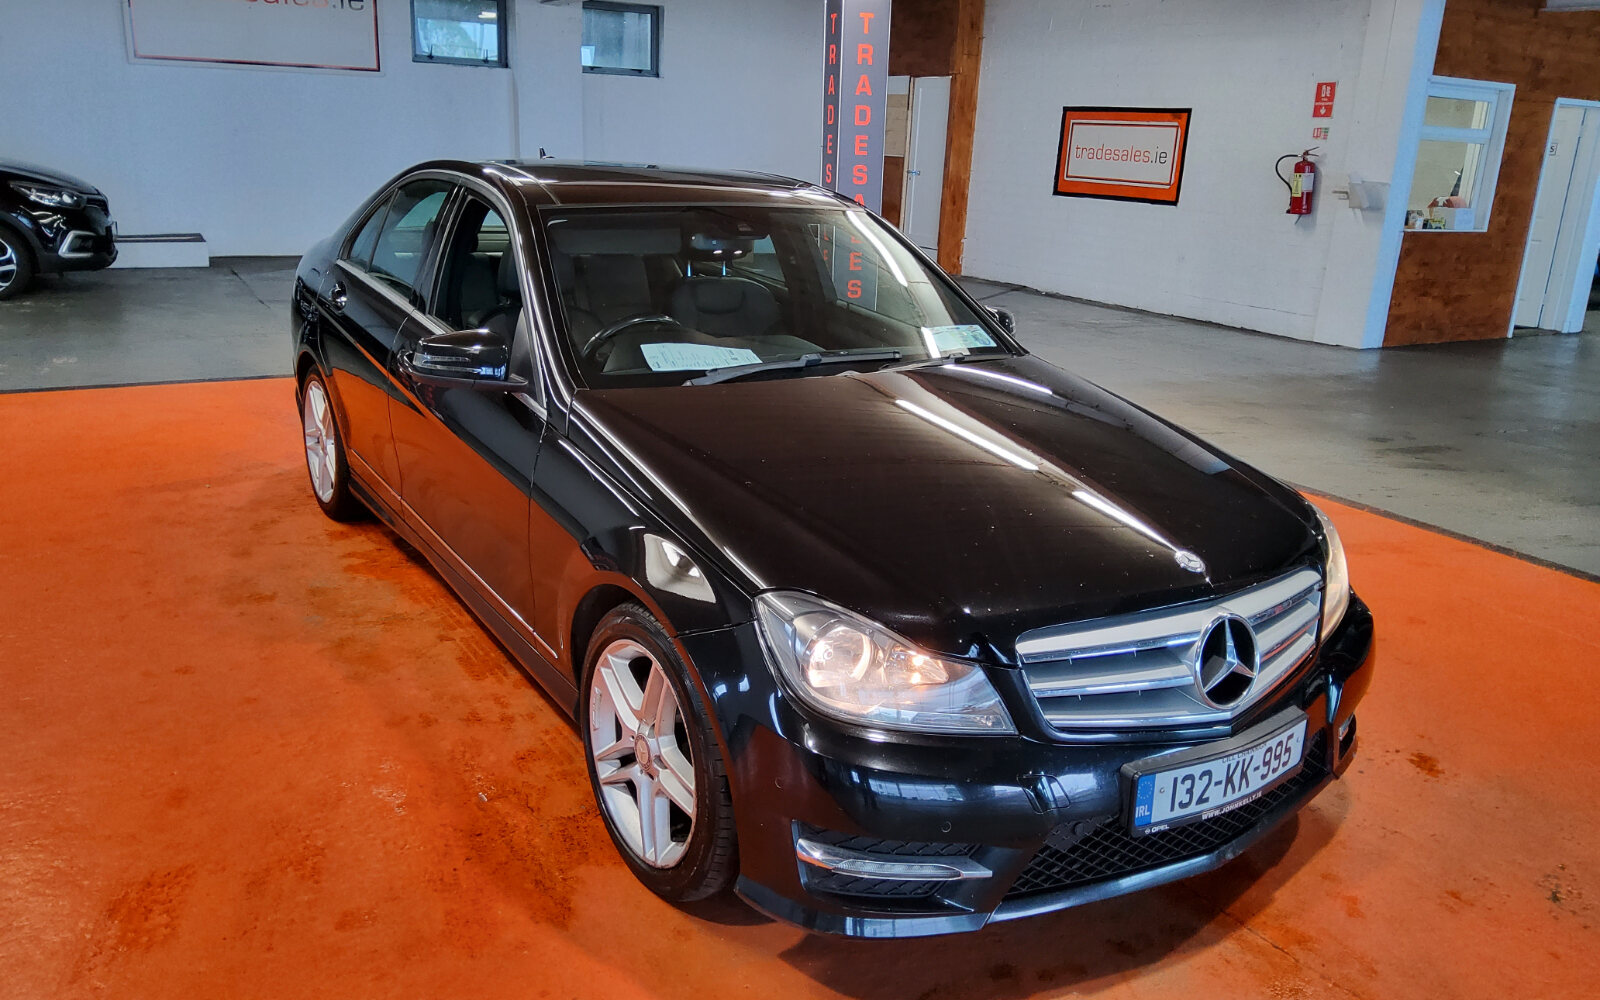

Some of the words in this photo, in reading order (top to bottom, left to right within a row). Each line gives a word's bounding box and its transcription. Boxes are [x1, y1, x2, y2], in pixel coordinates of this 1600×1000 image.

[1075, 144, 1168, 164] tradesales.ie
[1170, 733, 1294, 812] 132-KK-995
[1135, 805, 1150, 818] IRL
[1152, 824, 1169, 833] OPEL
